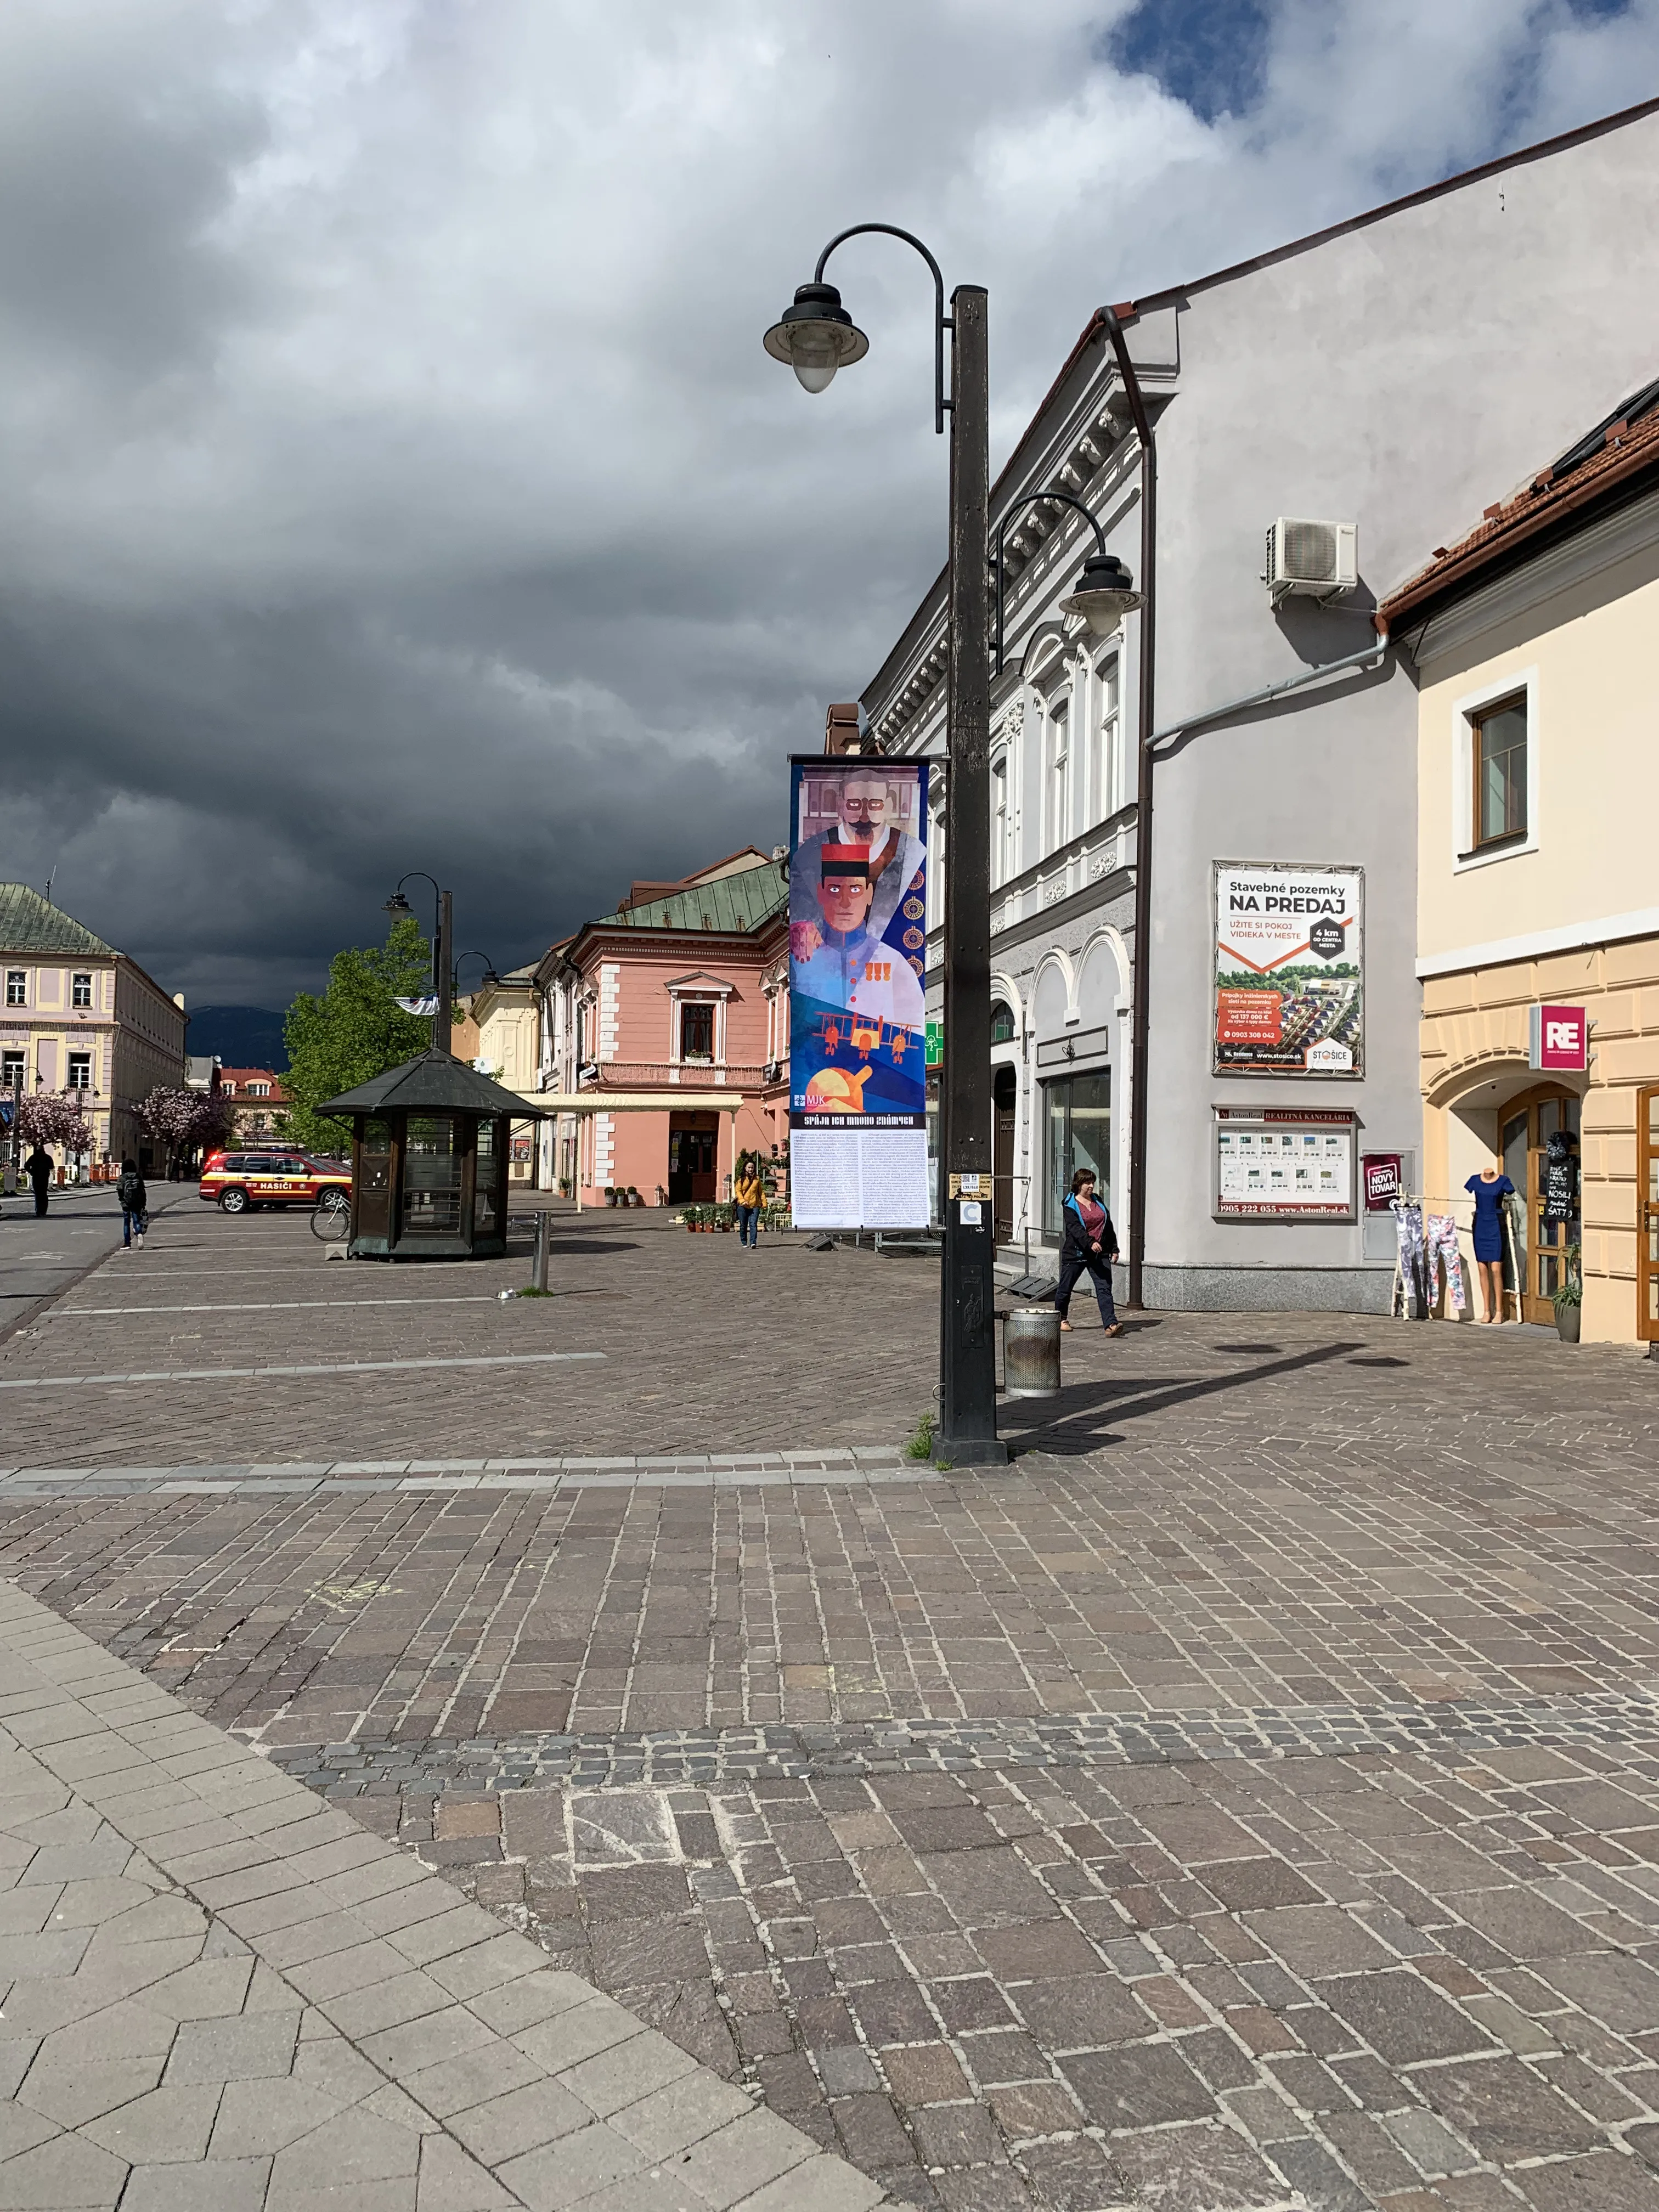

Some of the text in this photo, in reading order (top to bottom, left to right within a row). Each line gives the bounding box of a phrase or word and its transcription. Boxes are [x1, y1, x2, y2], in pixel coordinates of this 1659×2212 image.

[1230, 882, 1345, 897] Stavebné pozemky
[1230, 895, 1345, 915] NA PREDAJ
[1230, 920, 1253, 928] UŽITE
[1324, 929, 1339, 937] km
[1547, 1022, 1579, 1049] RE
[1313, 1050, 1347, 1060] STOŠICE
[807, 1095, 825, 1104] MJK
[1304, 1113, 1350, 1121] KANCELÁRIA
[1372, 1170, 1394, 1185] NOVÝ
[1370, 1181, 1396, 1195] TOVAR
[1548, 1190, 1571, 1199] NOSILI
[1279, 1205, 1349, 1214] www.AstonReal.sk
